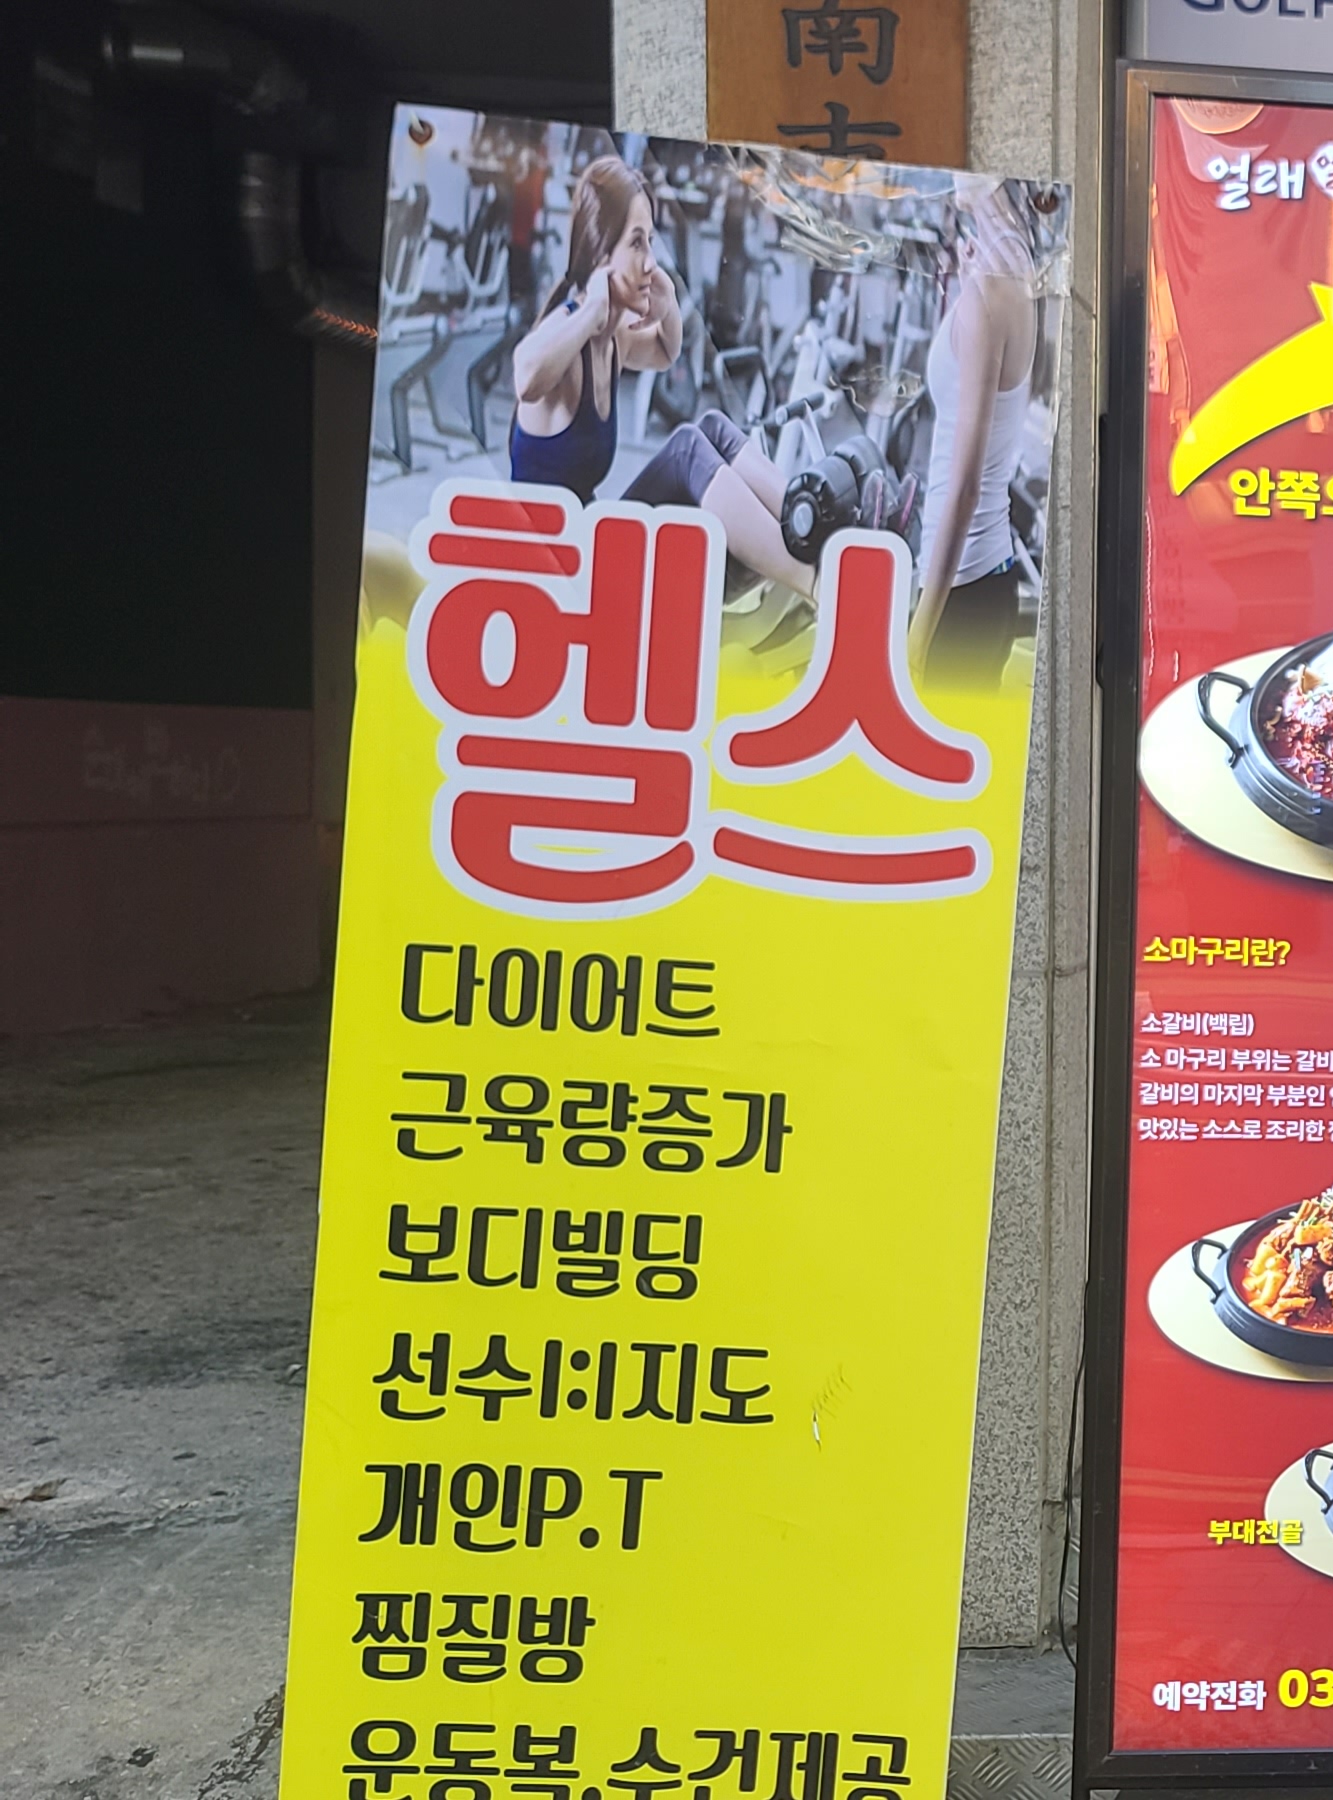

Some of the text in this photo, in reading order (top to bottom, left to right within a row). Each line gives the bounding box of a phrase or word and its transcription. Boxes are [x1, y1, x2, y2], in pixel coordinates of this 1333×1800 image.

[1208, 150, 1305, 211] 얼래
[427, 495, 977, 905] 헬스
[1143, 937, 1291, 967] 소마구리란?
[400, 943, 720, 1036] 다이어트
[1140, 1011, 1255, 1036] 소갈비(백립)
[1140, 1048, 1161, 1068] 소
[1166, 1048, 1226, 1070] 마구리
[1231, 1049, 1292, 1071] 부위는
[1140, 1083, 1199, 1105] 갈비의
[1203, 1084, 1262, 1106] 마지막
[1267, 1085, 1325, 1107] 부분인
[390, 1071, 793, 1173] 근육량증가
[1138, 1117, 1199, 1141] 맛있는
[1202, 1119, 1261, 1140] 소스로
[1266, 1119, 1325, 1142] 조리한
[379, 1204, 703, 1300] 보디빌딩
[357, 1462, 664, 1553] 개인P.T
[1207, 1519, 1303, 1545] 부대전골
[352, 1592, 597, 1683] 찜질방
[1152, 1679, 1267, 1711] 예약전화
